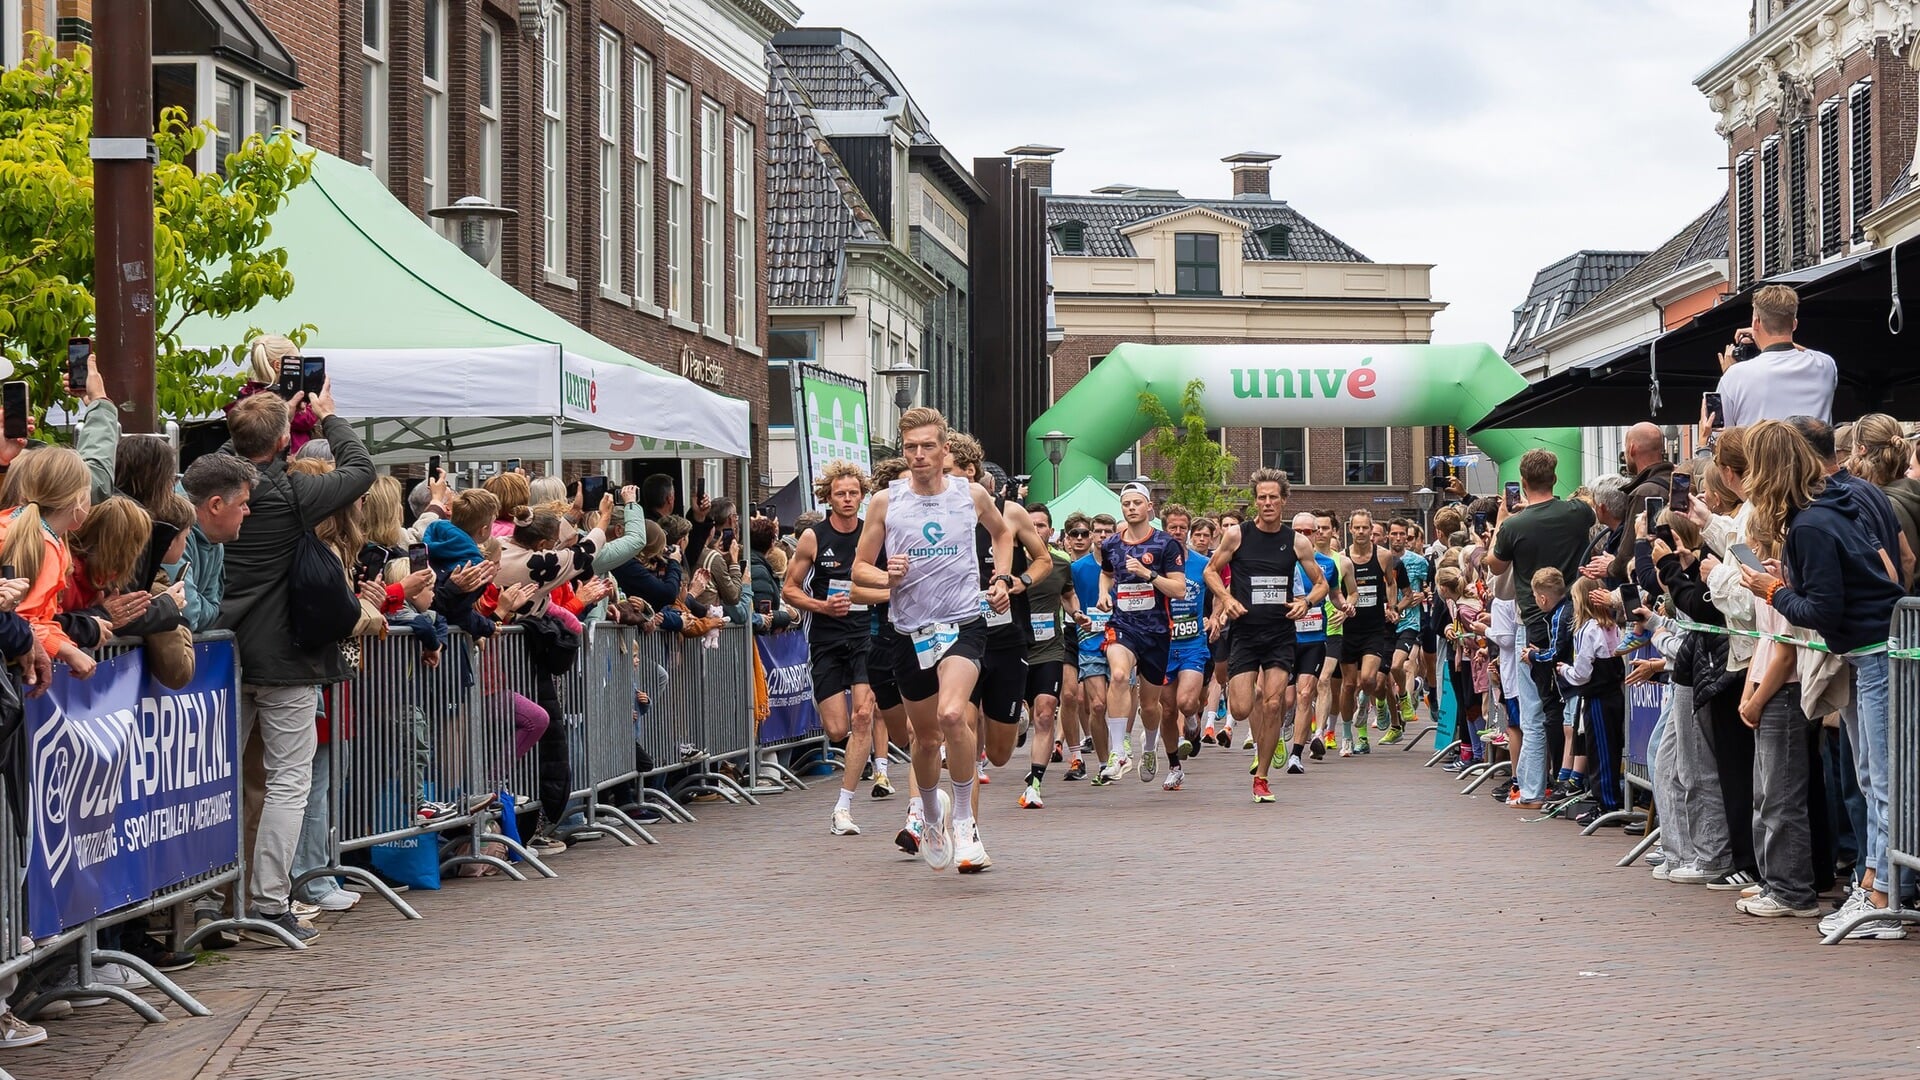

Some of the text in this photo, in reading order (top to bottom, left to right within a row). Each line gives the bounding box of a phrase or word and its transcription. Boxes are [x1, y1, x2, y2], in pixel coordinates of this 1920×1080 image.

[690, 351, 705, 381] Parc
[1230, 356, 1377, 399] univé
[565, 368, 597, 413] univé
[908, 544, 958, 558] runpoint
[1172, 620, 1198, 637] 7959
